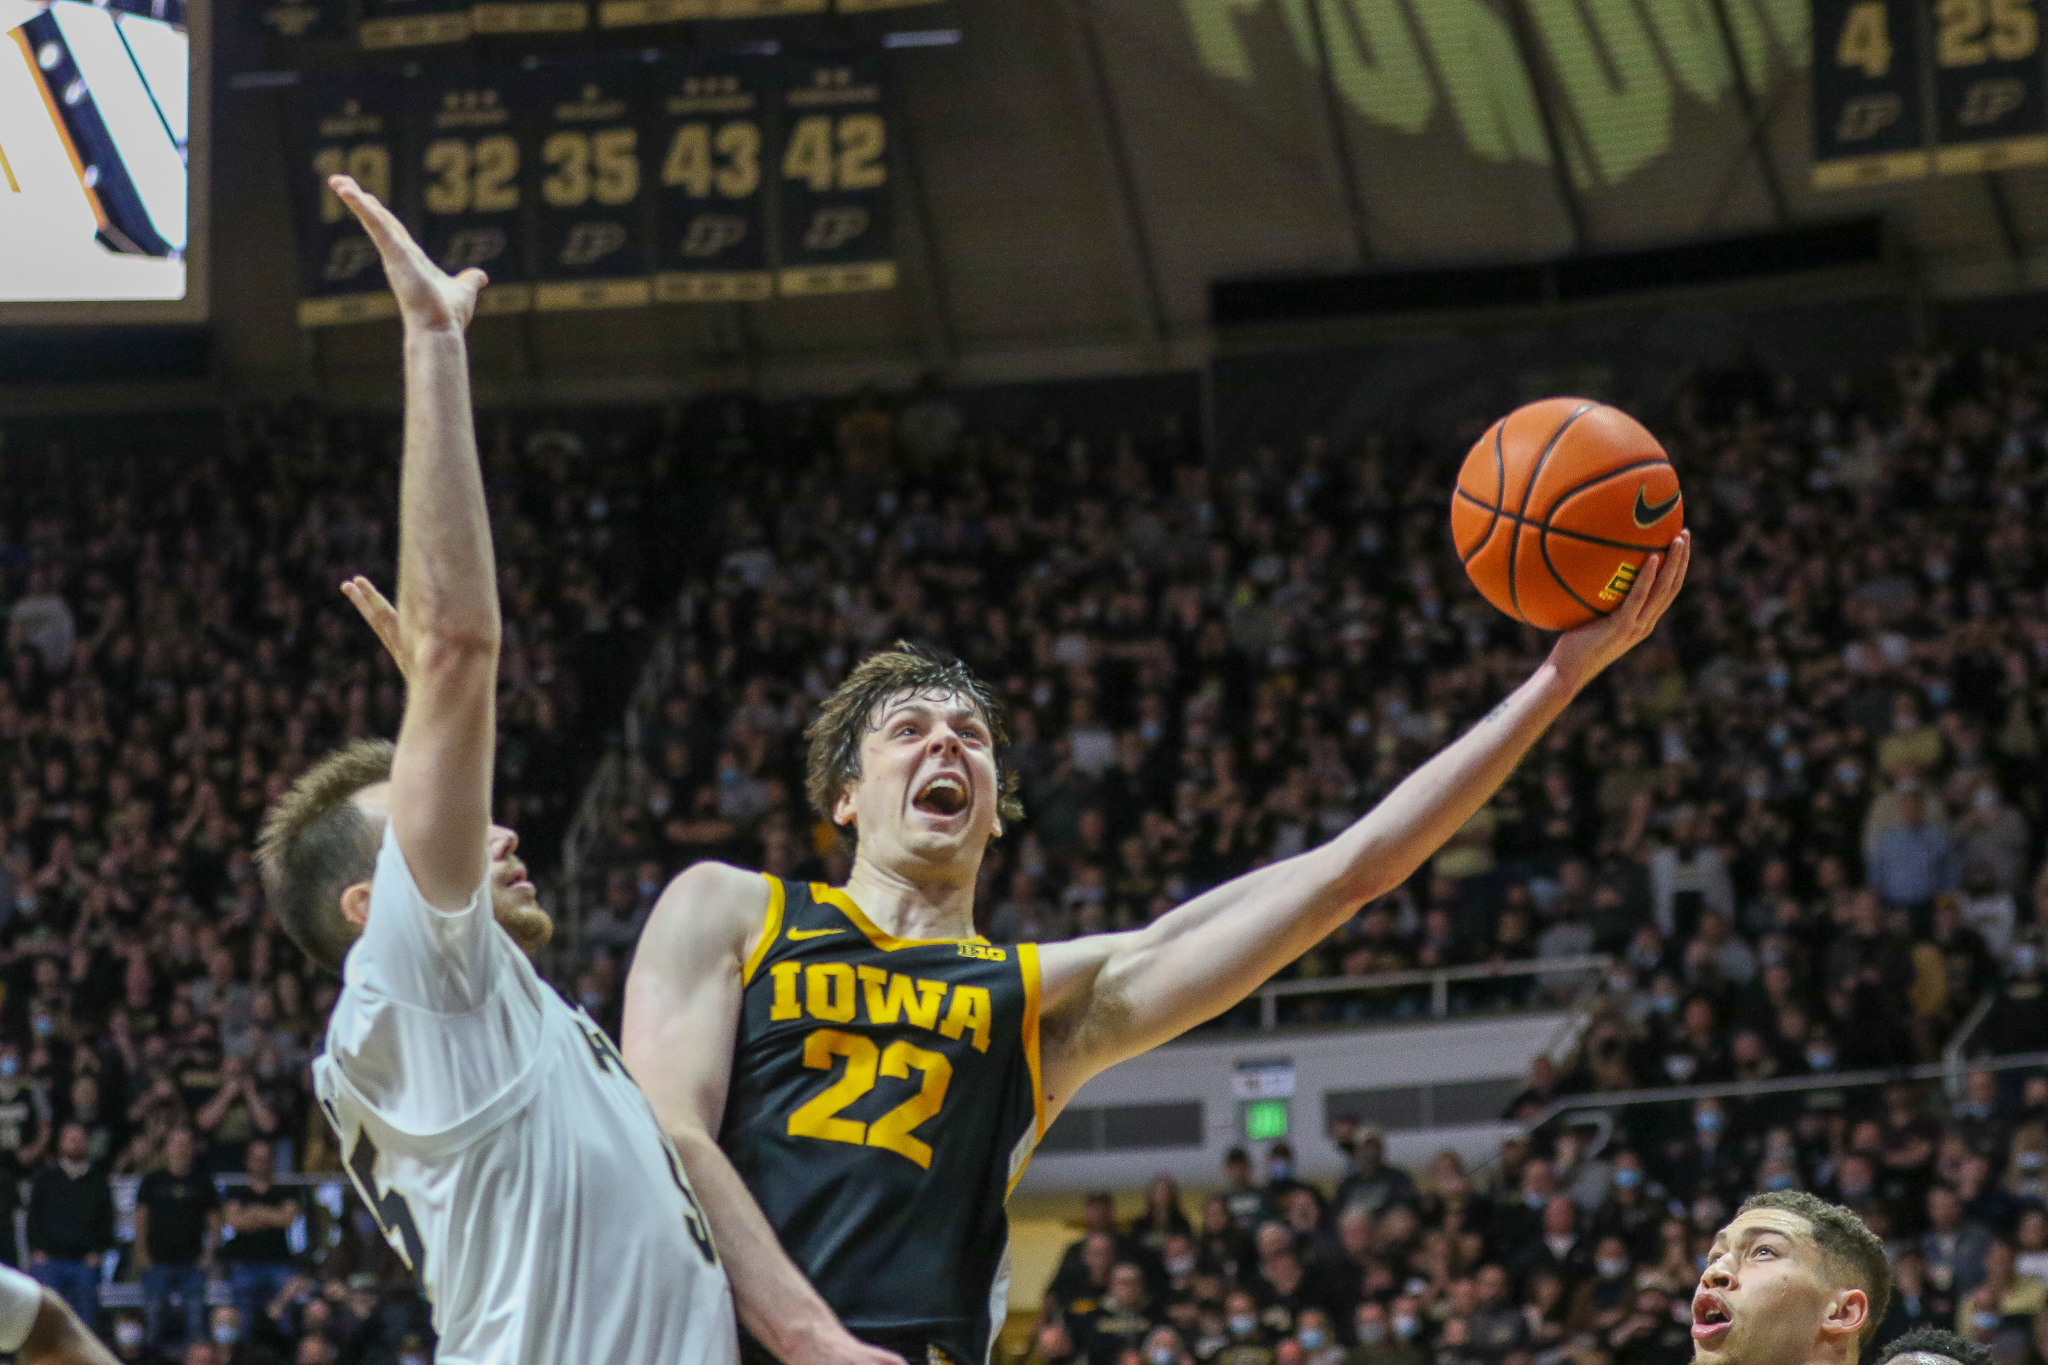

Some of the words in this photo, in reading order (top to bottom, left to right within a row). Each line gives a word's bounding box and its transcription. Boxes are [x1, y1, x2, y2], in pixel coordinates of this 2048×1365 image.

[1837, 1, 1891, 76] 4
[1938, 0, 2038, 66] 25
[426, 136, 519, 214] 32
[543, 128, 640, 207] 35
[662, 120, 761, 197] 43
[782, 114, 886, 191] 42
[769, 961, 992, 1054] IOWA
[787, 1028, 953, 1170] 22
